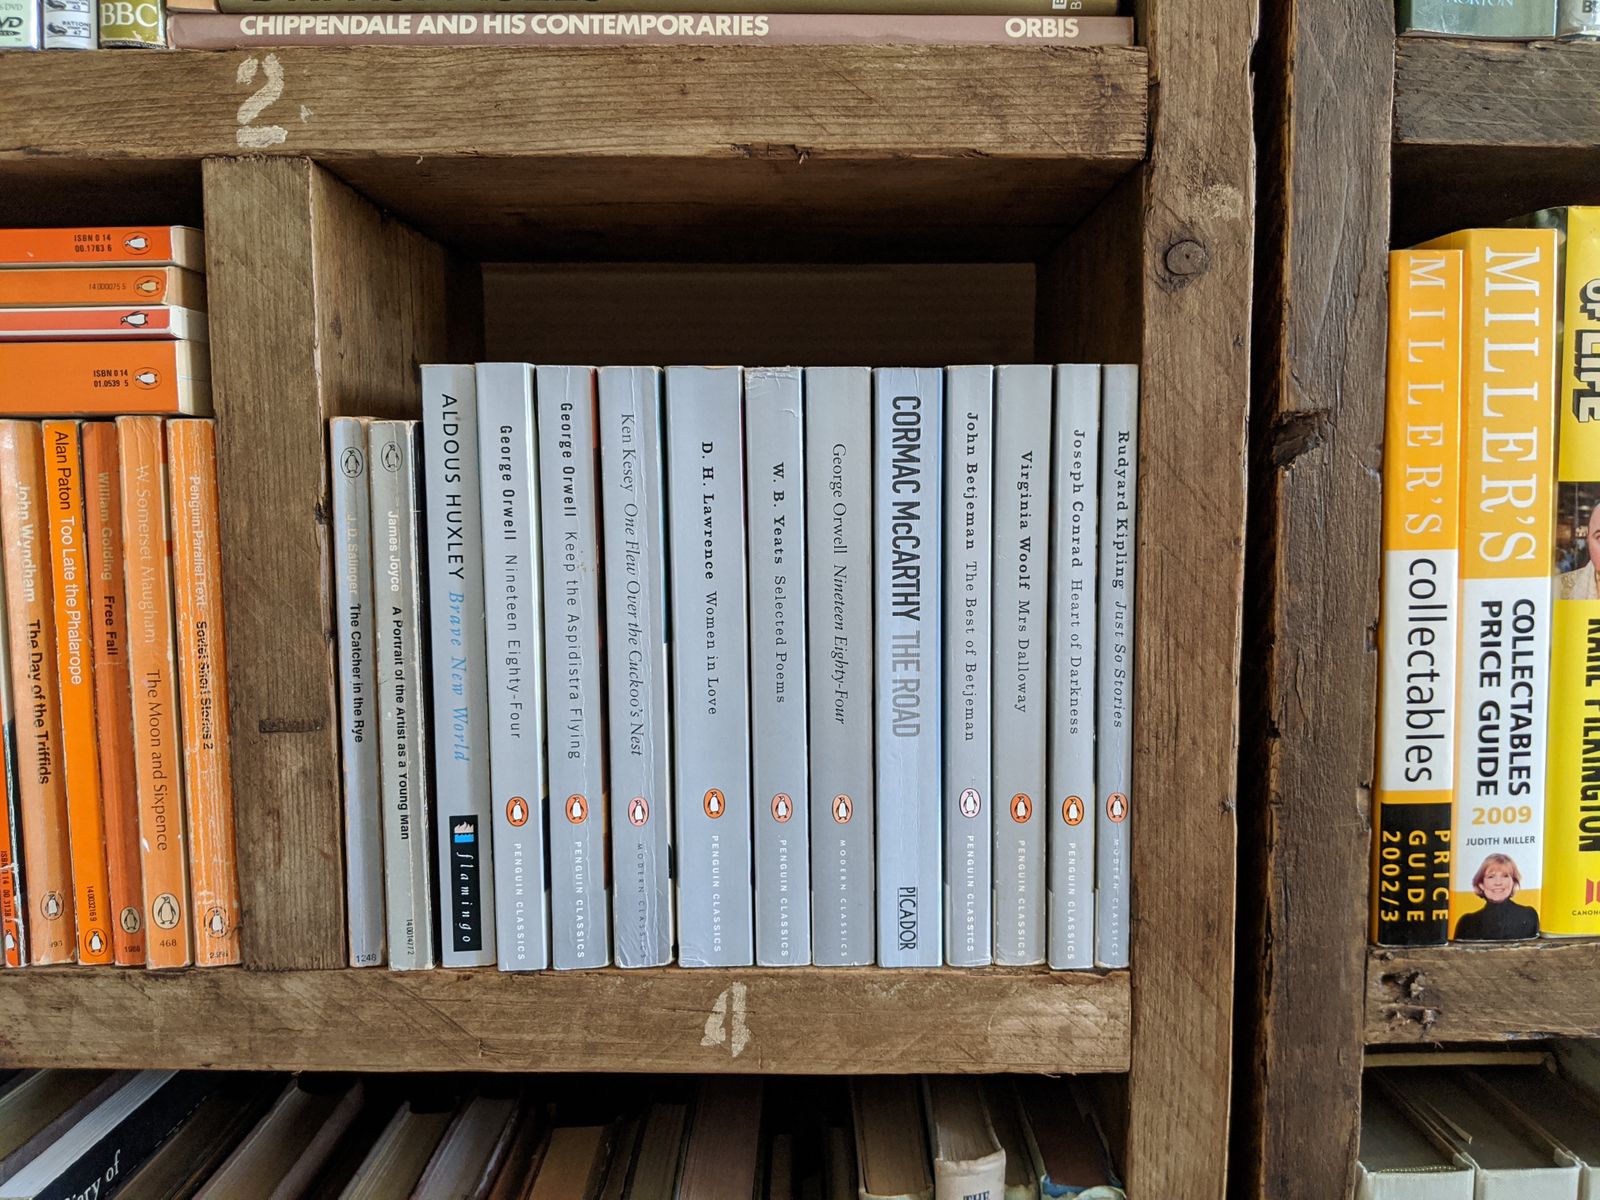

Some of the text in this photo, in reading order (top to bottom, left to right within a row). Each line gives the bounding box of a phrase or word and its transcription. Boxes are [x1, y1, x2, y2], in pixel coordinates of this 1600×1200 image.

[0, 17, 23, 28] VD
[102, 2, 158, 27] BBC
[236, 52, 288, 148] 2
[240, 14, 769, 36] CHIPPENDALE AND HIS CONTEMPORARIES
[1005, 17, 1079, 38] ORBIS
[74, 234, 93, 242] ISBN
[1479, 246, 1541, 562] MILLER'S
[55, 431, 82, 686] Alan Paton Too Late the Phalarope
[99, 472, 118, 656] William Golding Free Fall
[188, 476, 204, 577] Penguin Parallel
[441, 393, 470, 761] ALDOUS HUXLEY Brave New World
[499, 425, 523, 738] George Orwell Nineteen Eighty-Four
[559, 402, 583, 759] George Orwell Keep the Aspidistra Flying
[620, 414, 644, 756] Ken Kesey One Flew Over the Cuckoo's Nest
[702, 441, 719, 715] D. H. Lawrence Women in Love
[773, 462, 787, 703] W. B. Yeats Selected Poems
[829, 443, 848, 725] George Orwell Nineteen Eighty-Four
[892, 395, 921, 738] CORMAC McCARTHY THE ROAD
[962, 412, 978, 741] John Betjeman The Best of Betjeman
[1015, 451, 1033, 713] Virginia Woolf Mrs Dalloway
[1070, 429, 1085, 735] Joseph Conrad Heart of Darkness
[1112, 431, 1130, 728] Rudyard Kipling Just So Stories
[1404, 256, 1447, 783] MILLER'S collectables
[17, 523, 51, 785] Wyndham The Day of the Triffids
[136, 488, 168, 851] Somerset Maugham The Moon and Sixpence
[347, 543, 365, 743] Salinger The Catcher in the Rye
[387, 510, 410, 840] James Joyce A Portrait of the Artist as Young Man
[1477, 600, 1502, 796] PRICE GUIDE
[1508, 599, 1535, 795] COLLECTABLES
[456, 852, 475, 943] flamingo
[514, 843, 525, 961] PENGUIN CLASSICS
[574, 841, 585, 959] PENGUIN CLASSICS
[779, 839, 788, 957] PENGUIN CLASSICS
[1067, 842, 1076, 960] PENGUIN CLASSICS
[1381, 831, 1400, 922] 2002/3
[1407, 830, 1427, 922] GUIDE
[1433, 830, 1450, 920] PRICE
[1466, 836, 1535, 846] JUDITH MILLER
[1472, 806, 1532, 825] 2009
[160, 939, 177, 948] 468
[355, 954, 377, 963] 1248
[899, 886, 918, 951] PICADOR
[105, 1149, 120, 1183] of
